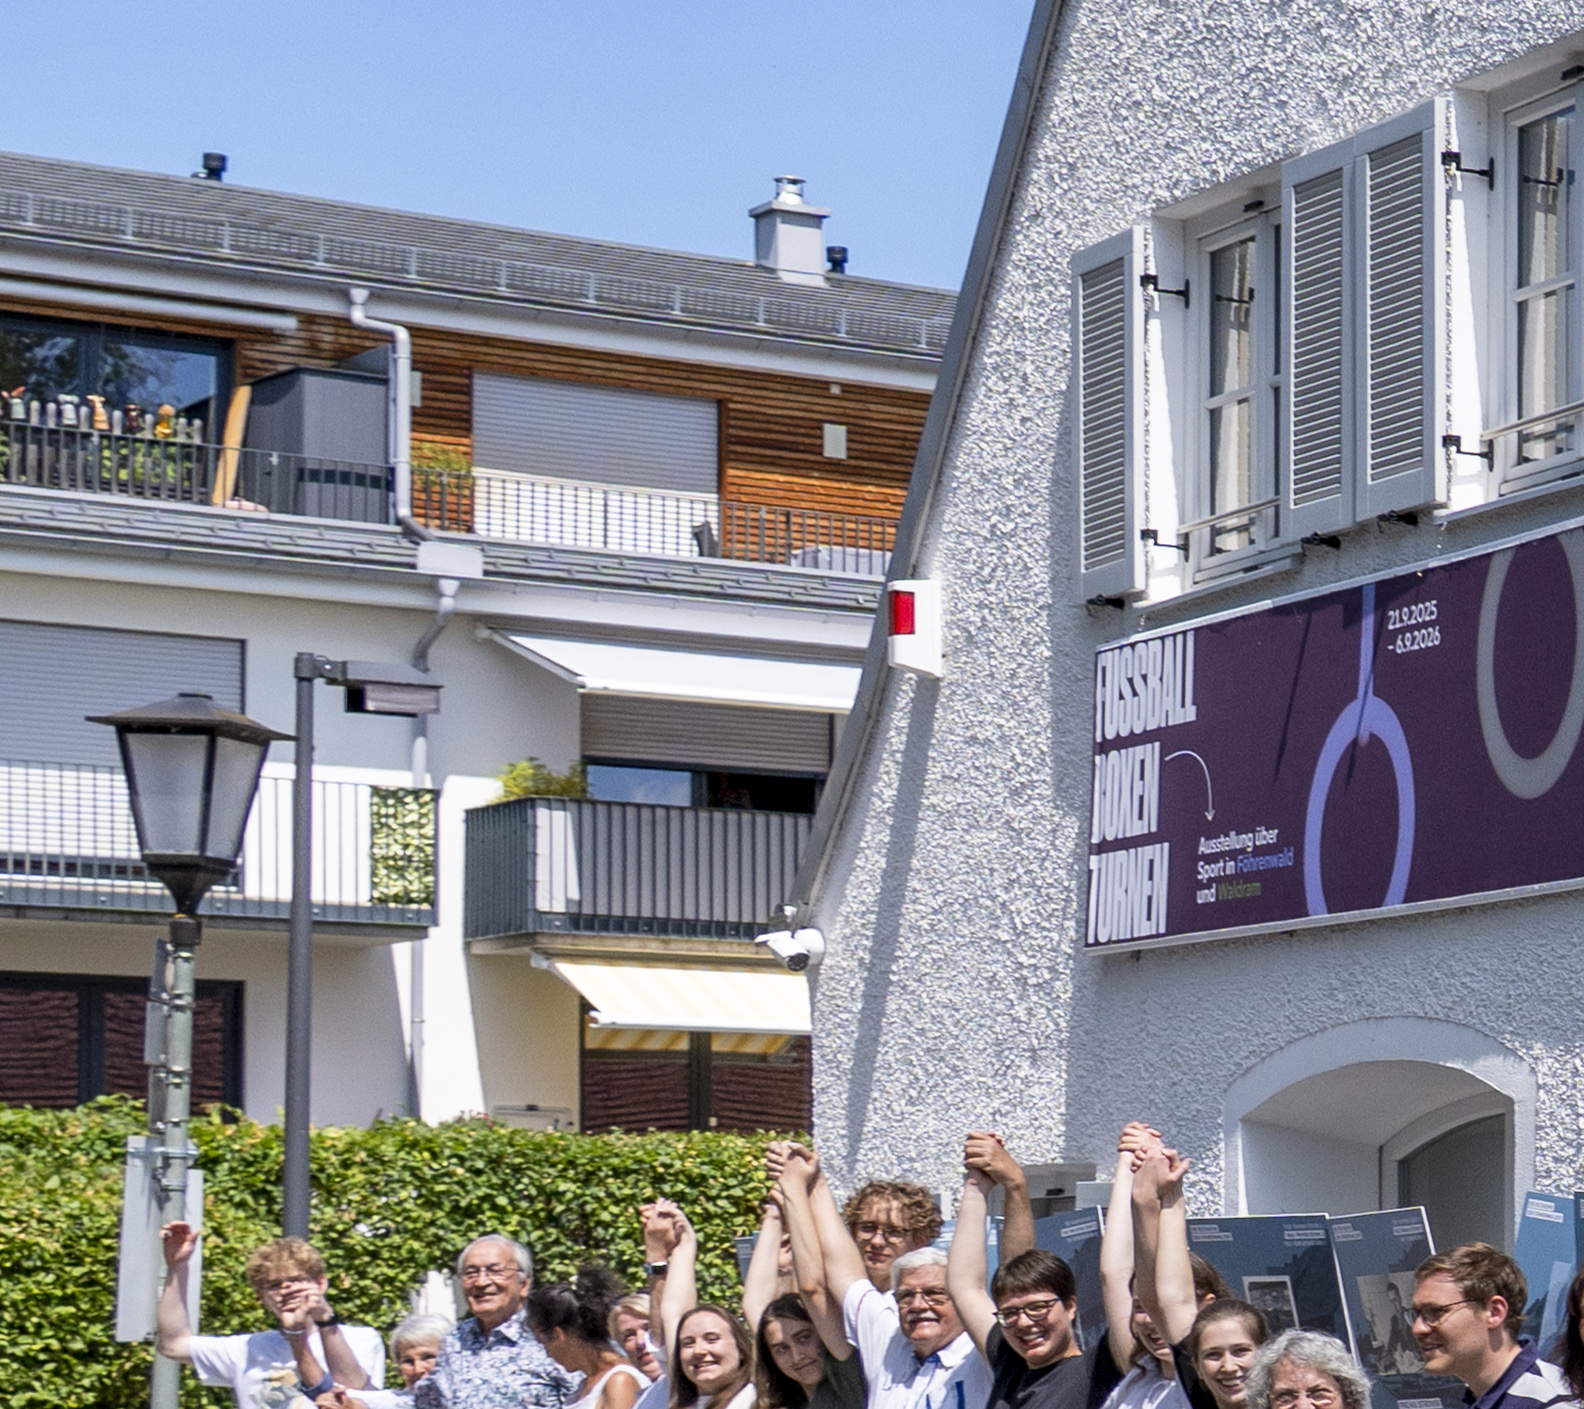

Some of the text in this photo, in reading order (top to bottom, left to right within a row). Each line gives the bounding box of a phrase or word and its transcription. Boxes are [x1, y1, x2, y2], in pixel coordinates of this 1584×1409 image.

[1387, 599, 1438, 630] 21.9.2025
[1395, 625, 1441, 654] 6.9.2026
[1095, 630, 1197, 742] FUSSBALL
[1091, 741, 1161, 844] BOXEN
[1198, 825, 1279, 855] Ausstellung über
[1197, 846, 1294, 883] Sport in Föhrenwald
[1087, 842, 1170, 944] TURNEN
[1196, 880, 1262, 904] und Waldram
